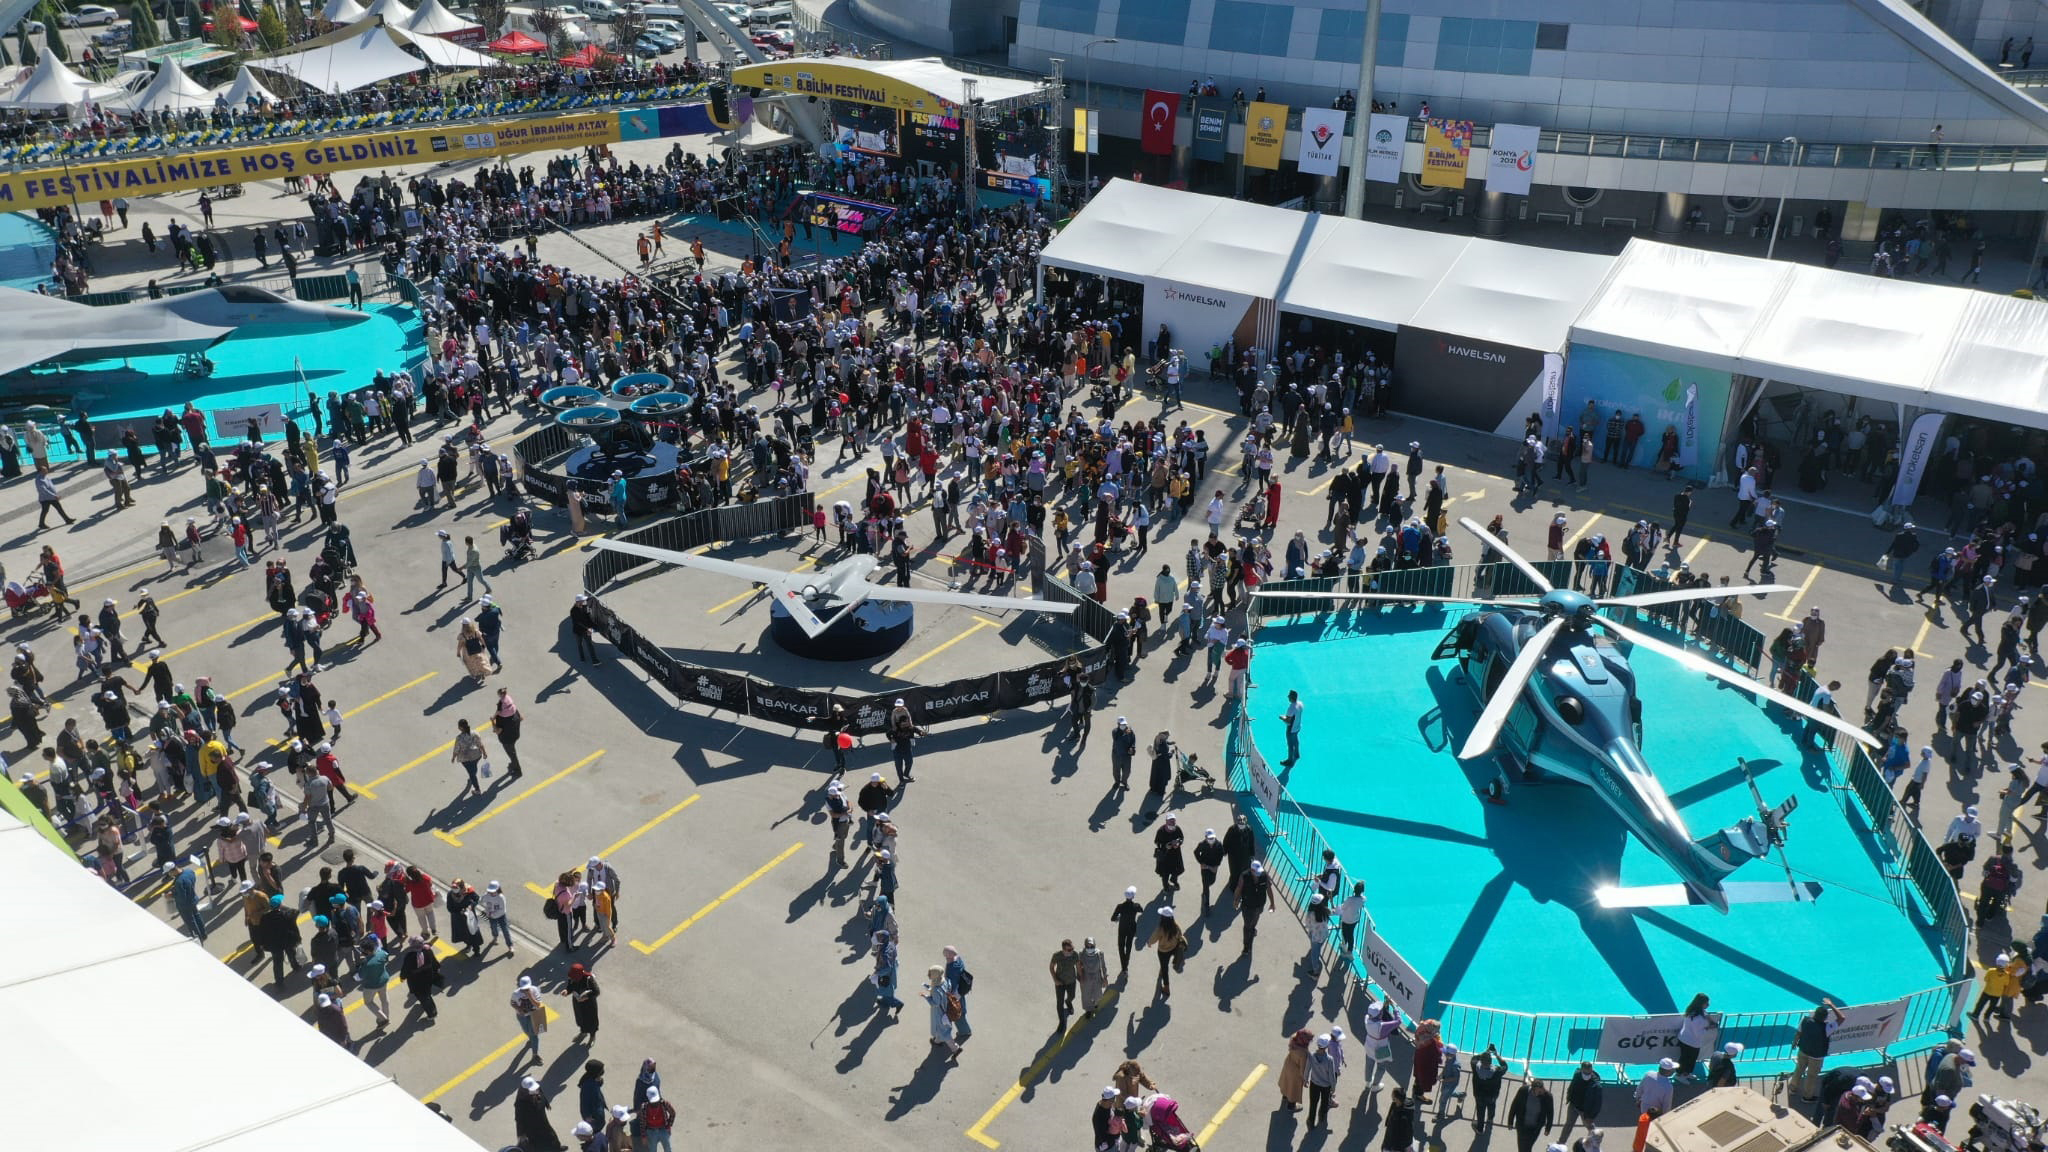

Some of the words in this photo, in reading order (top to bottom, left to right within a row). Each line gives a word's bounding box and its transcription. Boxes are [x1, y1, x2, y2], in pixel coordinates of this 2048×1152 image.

[797, 78, 833, 95] 8.BİLİM
[835, 84, 886, 103] FESTİVALİ
[497, 127, 528, 140] UĞUR
[531, 121, 575, 136] İBRAHİM
[578, 119, 608, 131] ALTAY
[1200, 116, 1222, 126] BENİM
[1307, 151, 1332, 161] TÜBİTAK
[1427, 158, 1464, 169] FESTİVALİ
[25, 157, 232, 199] FESTİVALİMİZE
[241, 152, 297, 174] HOŞ
[305, 134, 419, 166] GELDİNİZ
[1178, 292, 1226, 308] HAVELSAN
[1448, 344, 1507, 365] HAVELSAN
[1905, 432, 1929, 477] roketsan
[765, 699, 818, 715] BAYKAR
[935, 691, 989, 709] BAYKAR
[1366, 945, 1388, 976] GÜÇ
[1388, 971, 1414, 1001] KAT
[1617, 1034, 1659, 1050] GÜÇ
